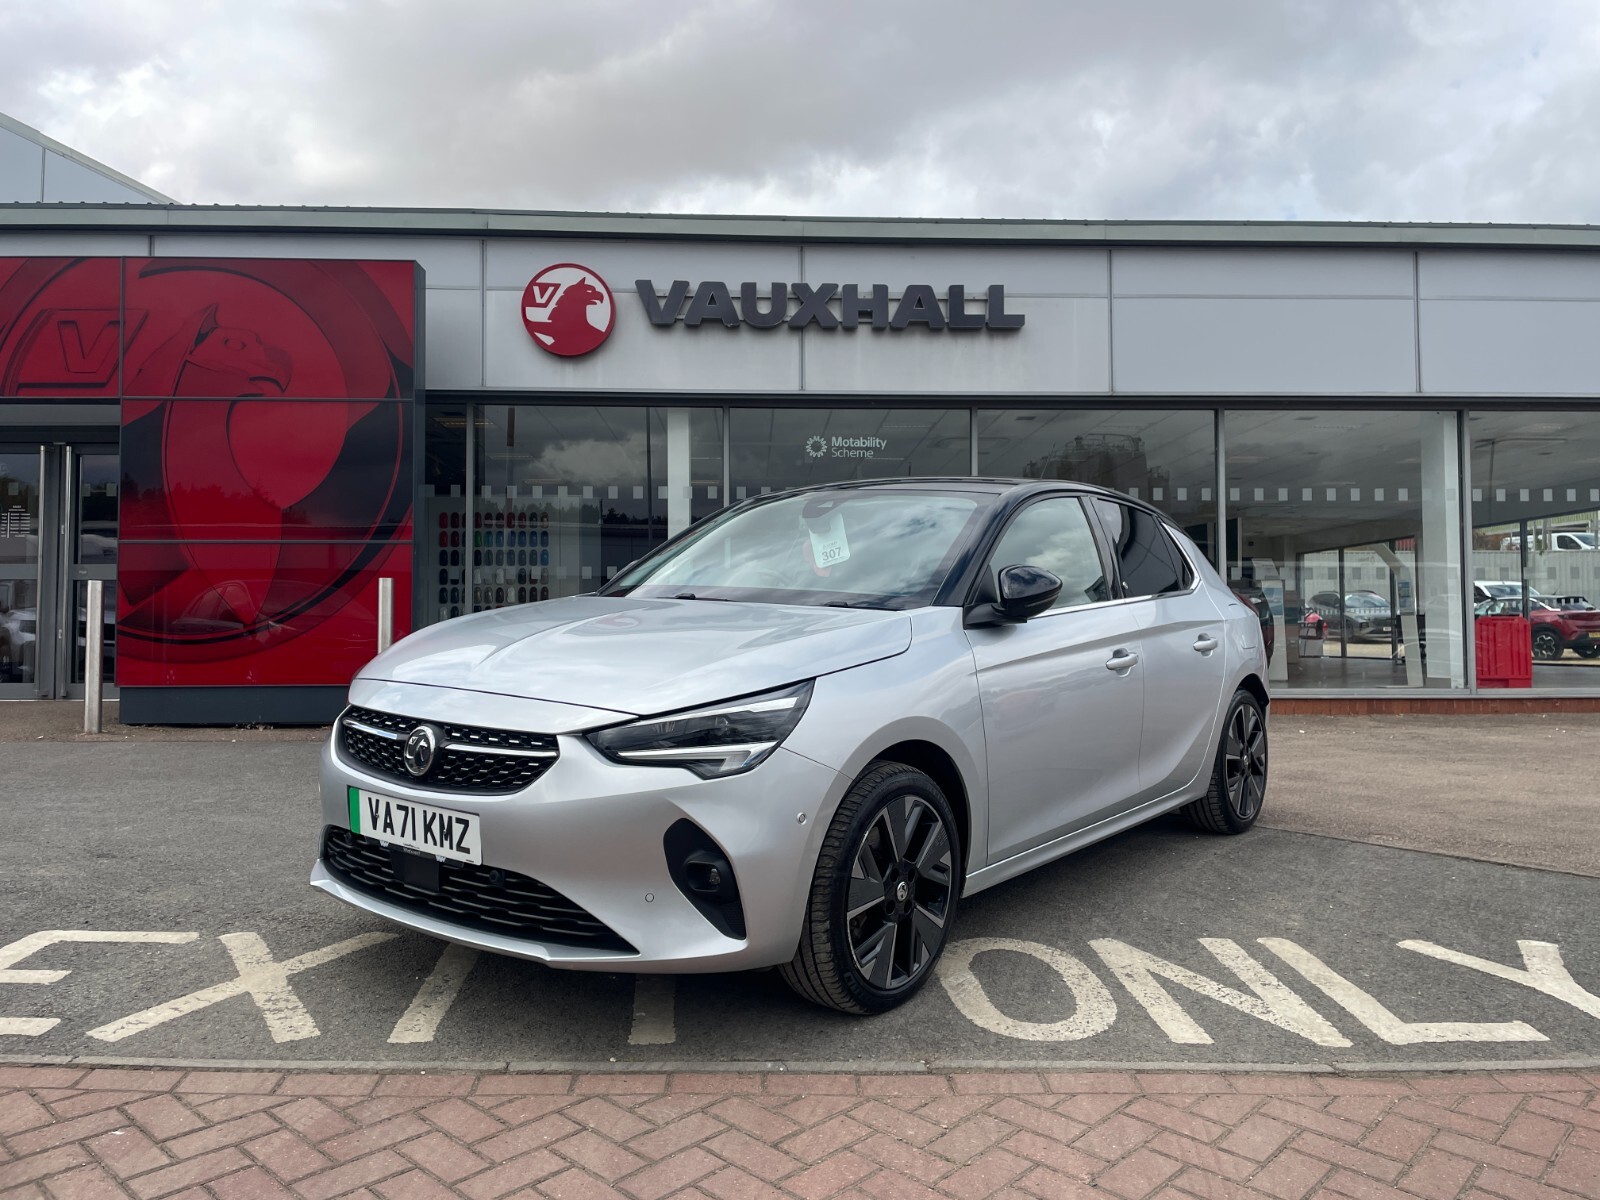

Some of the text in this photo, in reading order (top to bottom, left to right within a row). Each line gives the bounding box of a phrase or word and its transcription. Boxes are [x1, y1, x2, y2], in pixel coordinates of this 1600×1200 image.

[634, 279, 1026, 331] VAUXHALL
[831, 436, 887, 450] Motability
[831, 447, 874, 458] Scheme
[821, 546, 842, 561] 307
[367, 796, 471, 855] VA71 KMZ
[937, 936, 1600, 1048] ONLY
